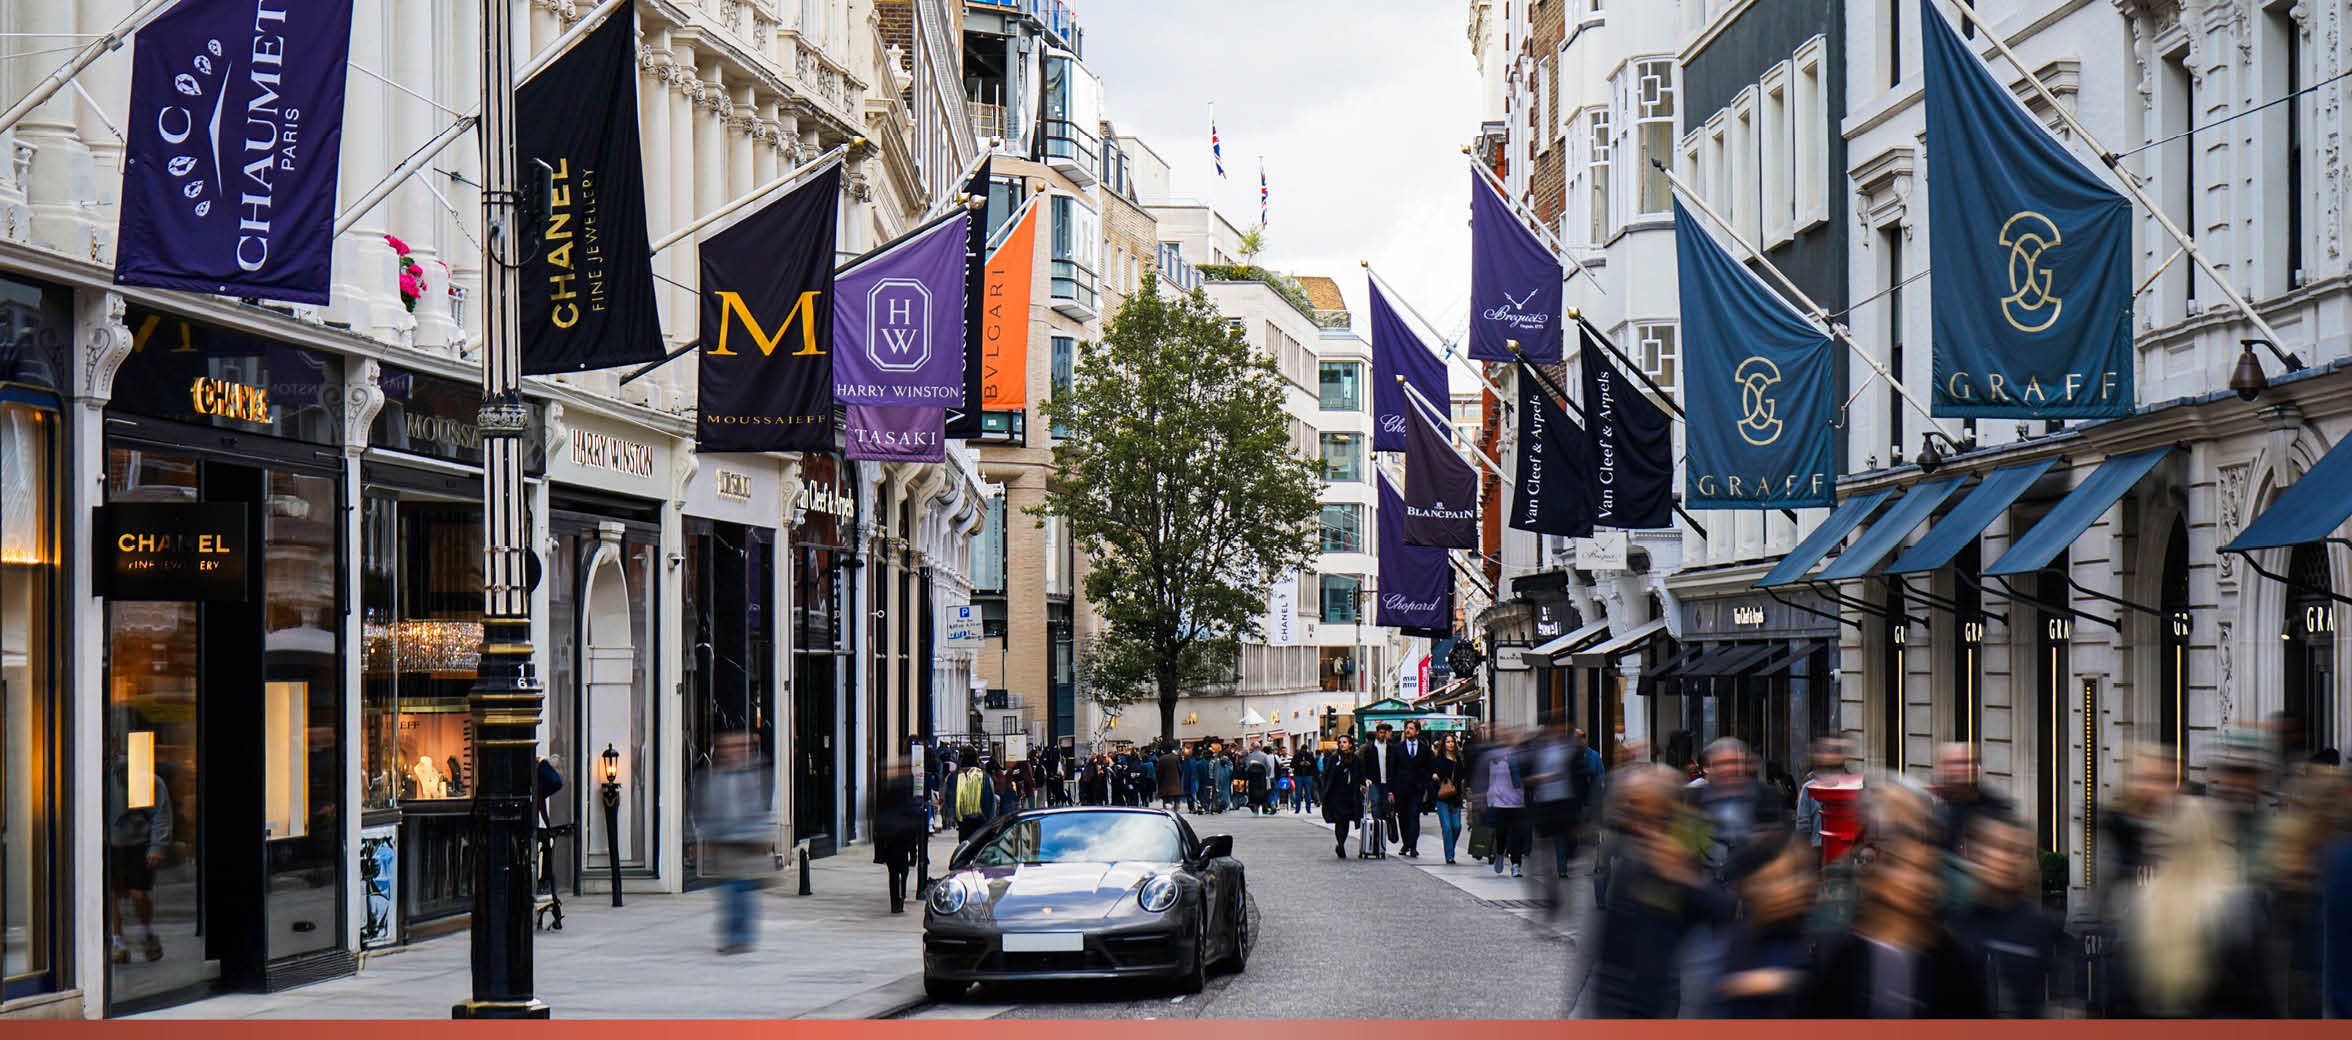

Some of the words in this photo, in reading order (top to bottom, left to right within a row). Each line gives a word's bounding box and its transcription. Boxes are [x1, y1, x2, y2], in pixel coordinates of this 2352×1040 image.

[237, 0, 287, 272] CHAUMET
[281, 107, 300, 171] PARIS
[582, 168, 603, 264] JEWELLERY
[545, 158, 579, 328] CHANEL
[588, 269, 605, 312] FINE
[707, 291, 827, 357] M
[1483, 304, 1549, 329] Breguet
[983, 268, 1005, 399] BVLGARI
[836, 383, 887, 398] HARRY
[891, 384, 959, 399] WINSTON
[1597, 371, 1615, 421] Arpels
[1950, 371, 2117, 401] GRAFF
[406, 412, 481, 448] MOUSSA
[707, 415, 826, 425] MOUSSAIEFF
[1529, 394, 1545, 439] Arpels
[854, 428, 936, 446] TASAKI
[1602, 426, 1613, 437] &
[570, 428, 607, 469] HARRY
[607, 436, 654, 478] WINSTON
[1532, 443, 1542, 453] &
[1599, 440, 1614, 485] Cleef
[1527, 455, 1542, 495] Cleef
[1698, 473, 1824, 496] GRAFF
[1407, 505, 1474, 519] BLANCPAIN
[1525, 499, 1539, 524] Van
[1598, 489, 1614, 518] Van
[118, 533, 230, 553] CHAEL
[1382, 593, 1441, 613] Chopard
[2048, 618, 2070, 640] GRA
[2306, 606, 2335, 633] GRA
